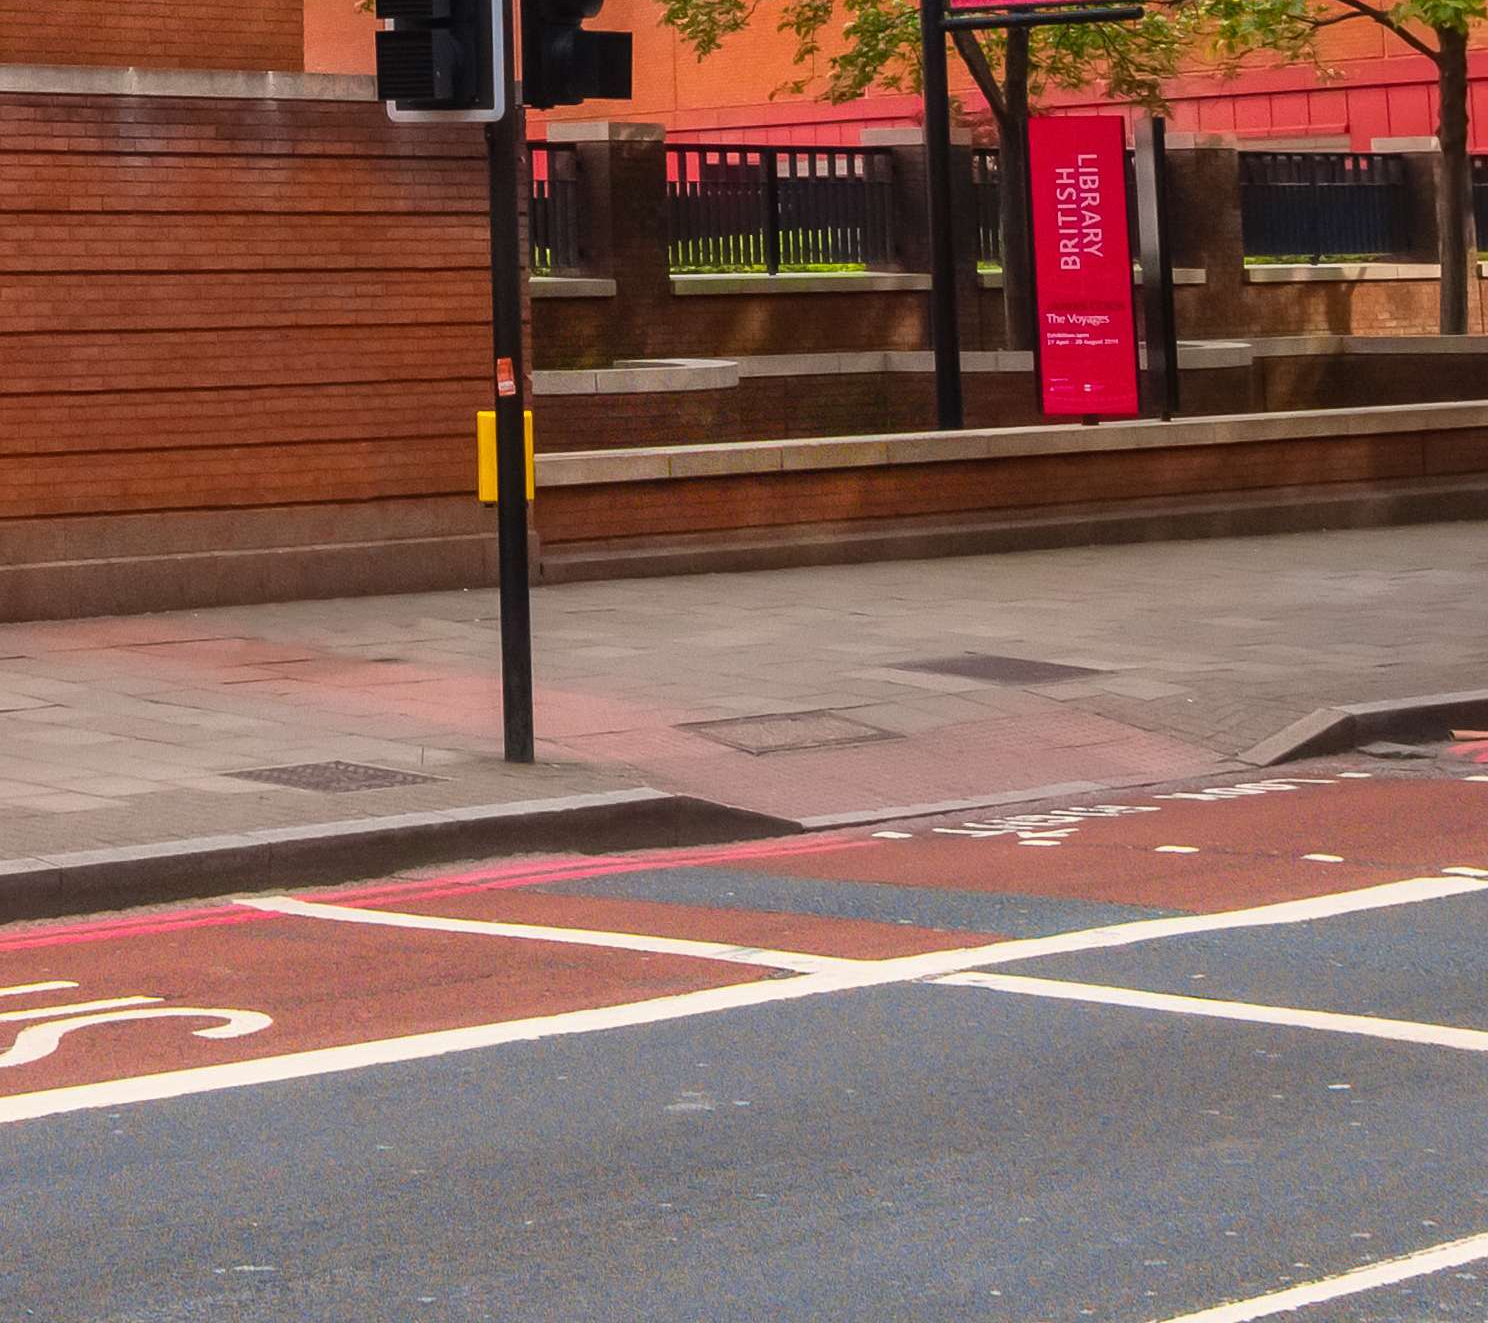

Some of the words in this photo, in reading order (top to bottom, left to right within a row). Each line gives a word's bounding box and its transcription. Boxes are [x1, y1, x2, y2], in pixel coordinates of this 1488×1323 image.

[1055, 167, 1081, 270] BRITISH
[1077, 153, 1104, 258] LIBRARY
[1046, 313, 1065, 324] The
[1066, 313, 1110, 327] Voyages
[1153, 777, 1340, 802] LOOK
